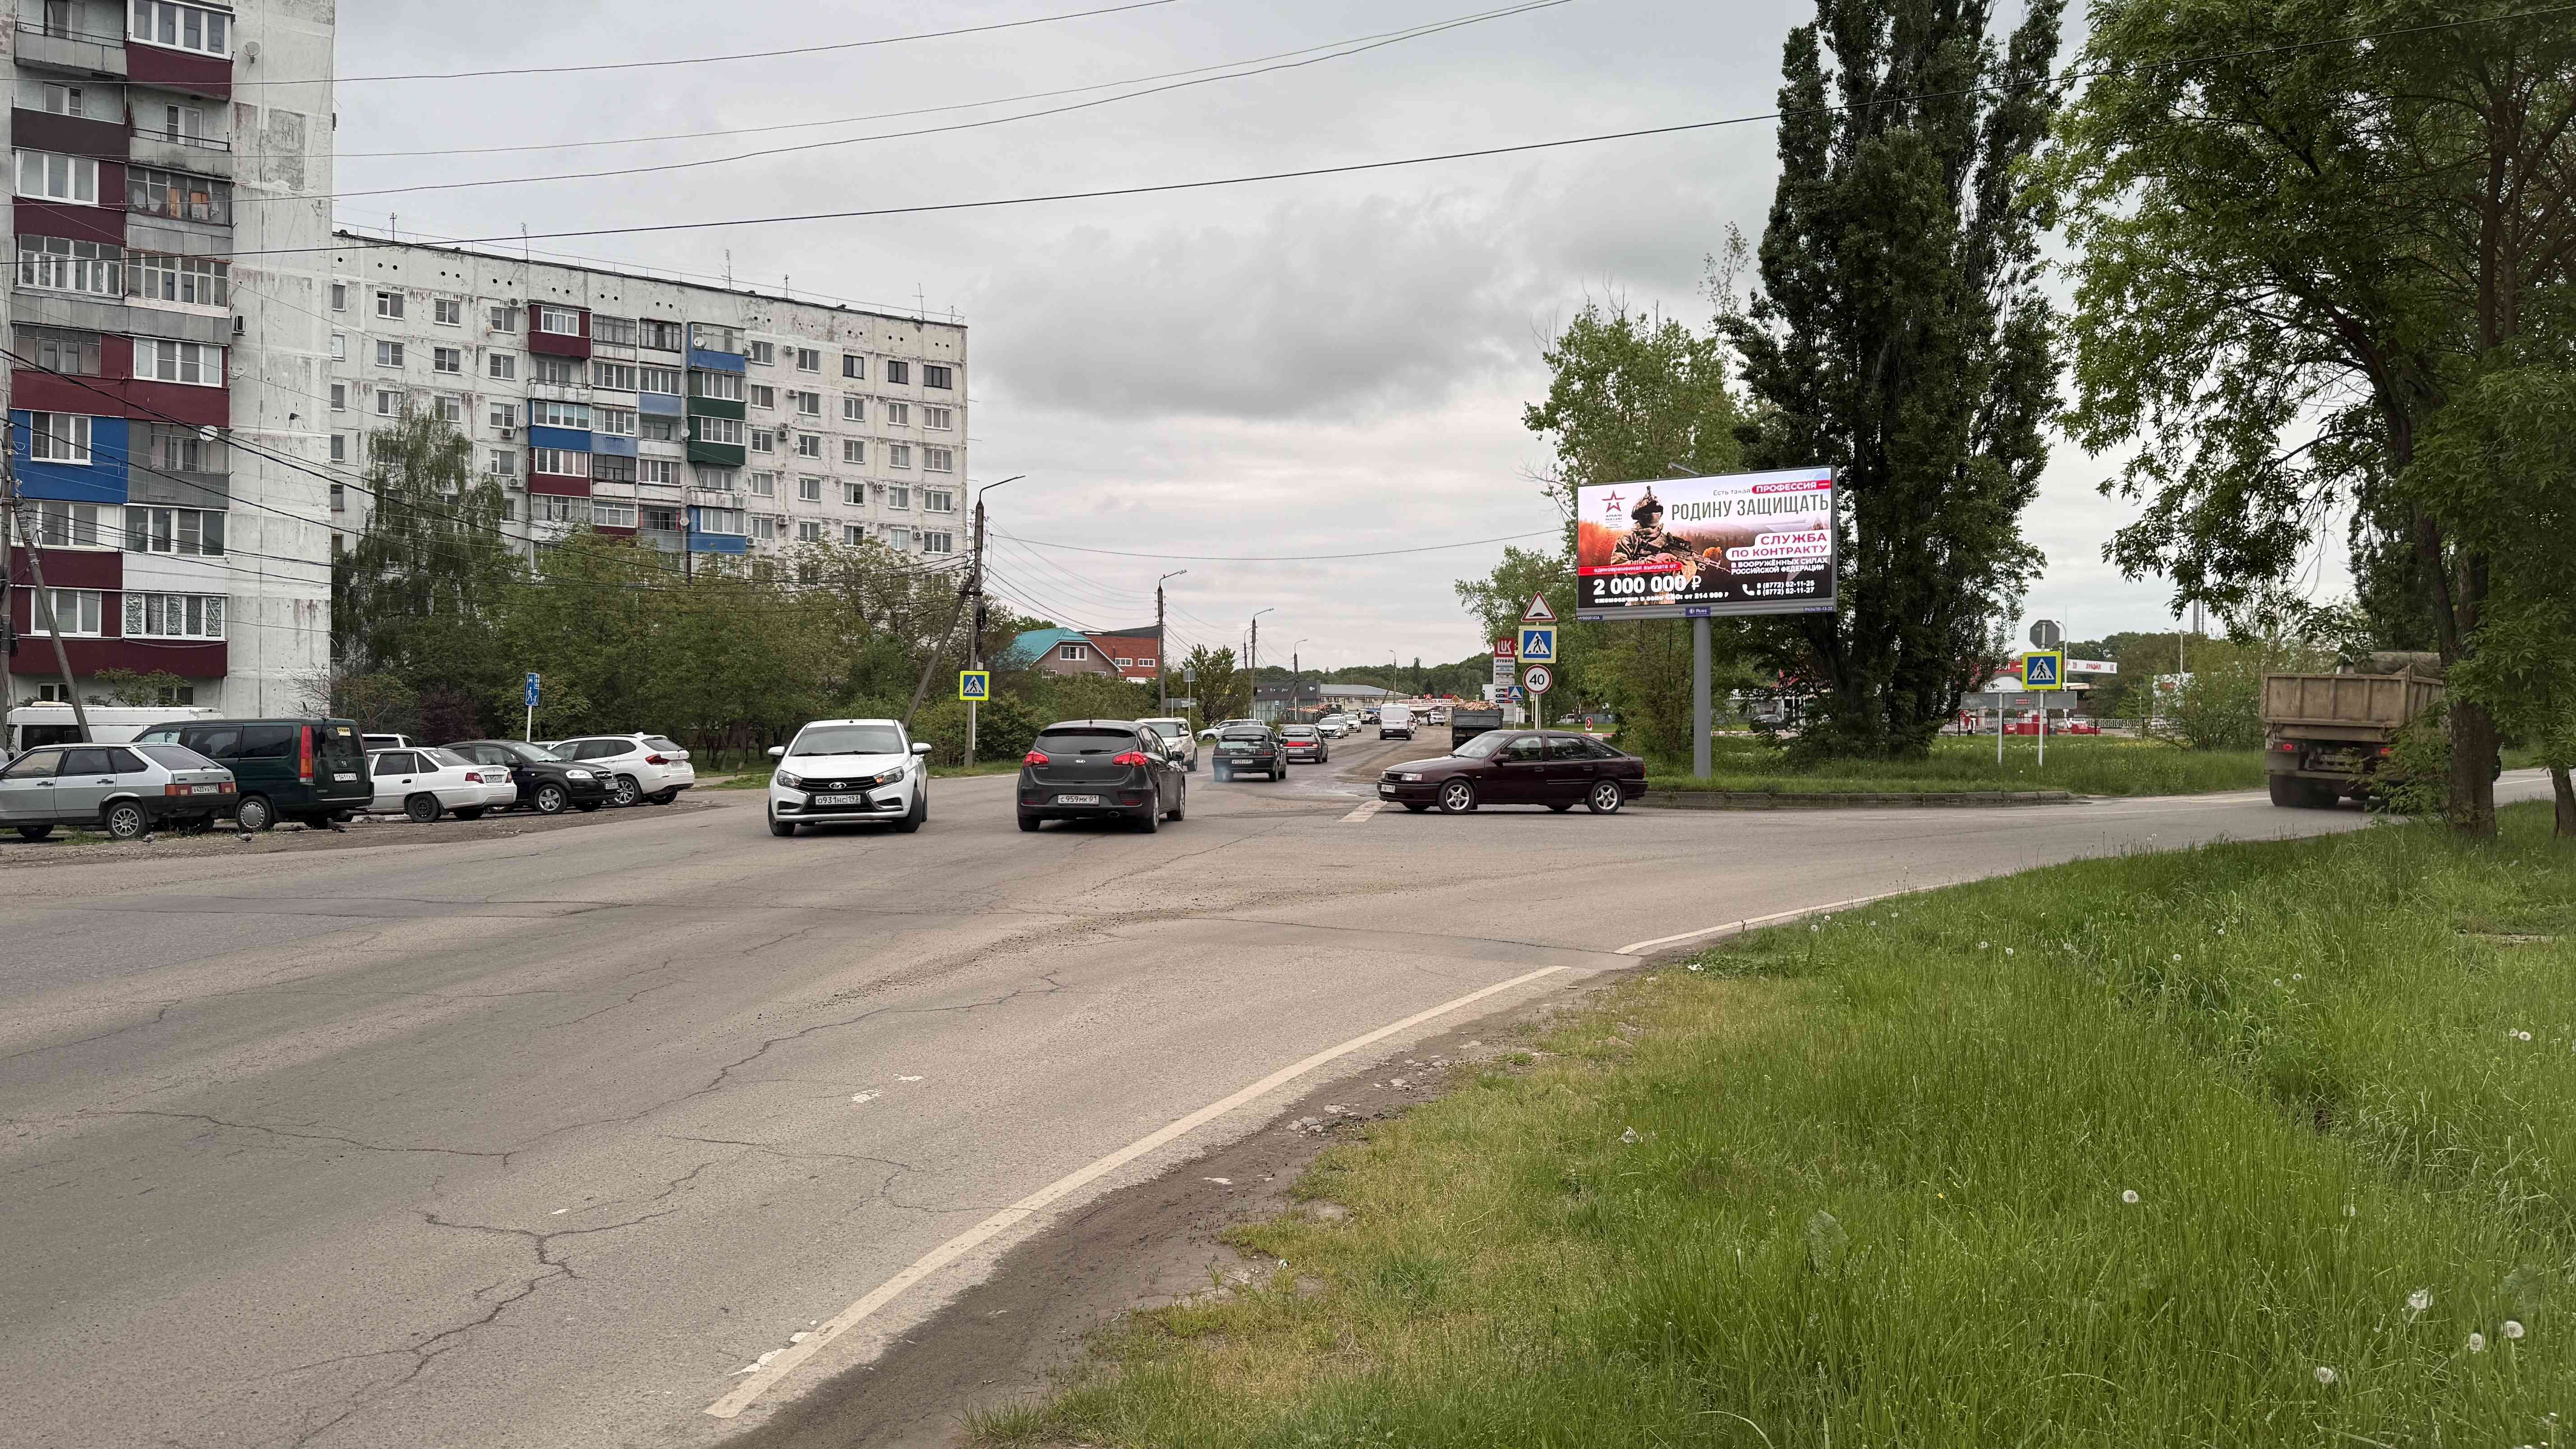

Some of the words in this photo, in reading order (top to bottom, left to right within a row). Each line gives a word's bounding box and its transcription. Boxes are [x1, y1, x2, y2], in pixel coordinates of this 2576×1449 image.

[1756, 482, 1817, 492] ПРОФЕССИЯ
[1672, 500, 1732, 521] РОДИНУ
[1737, 494, 1828, 516] ЗАЩИЩАТЬ
[1761, 533, 1827, 545] СЛУЖБА
[1753, 545, 1827, 557] КОНТРАКТУ
[1738, 559, 1799, 567] ВООРУЖЁННЫХ
[1731, 566, 1779, 575] РОССИЙСКОЙ
[1781, 564, 1824, 573] ФЕДЕРАЦИИ
[1593, 579, 1605, 595] 2
[1610, 577, 1646, 594] 000
[1651, 575, 1687, 593] 000
[1529, 674, 1545, 685] 40
